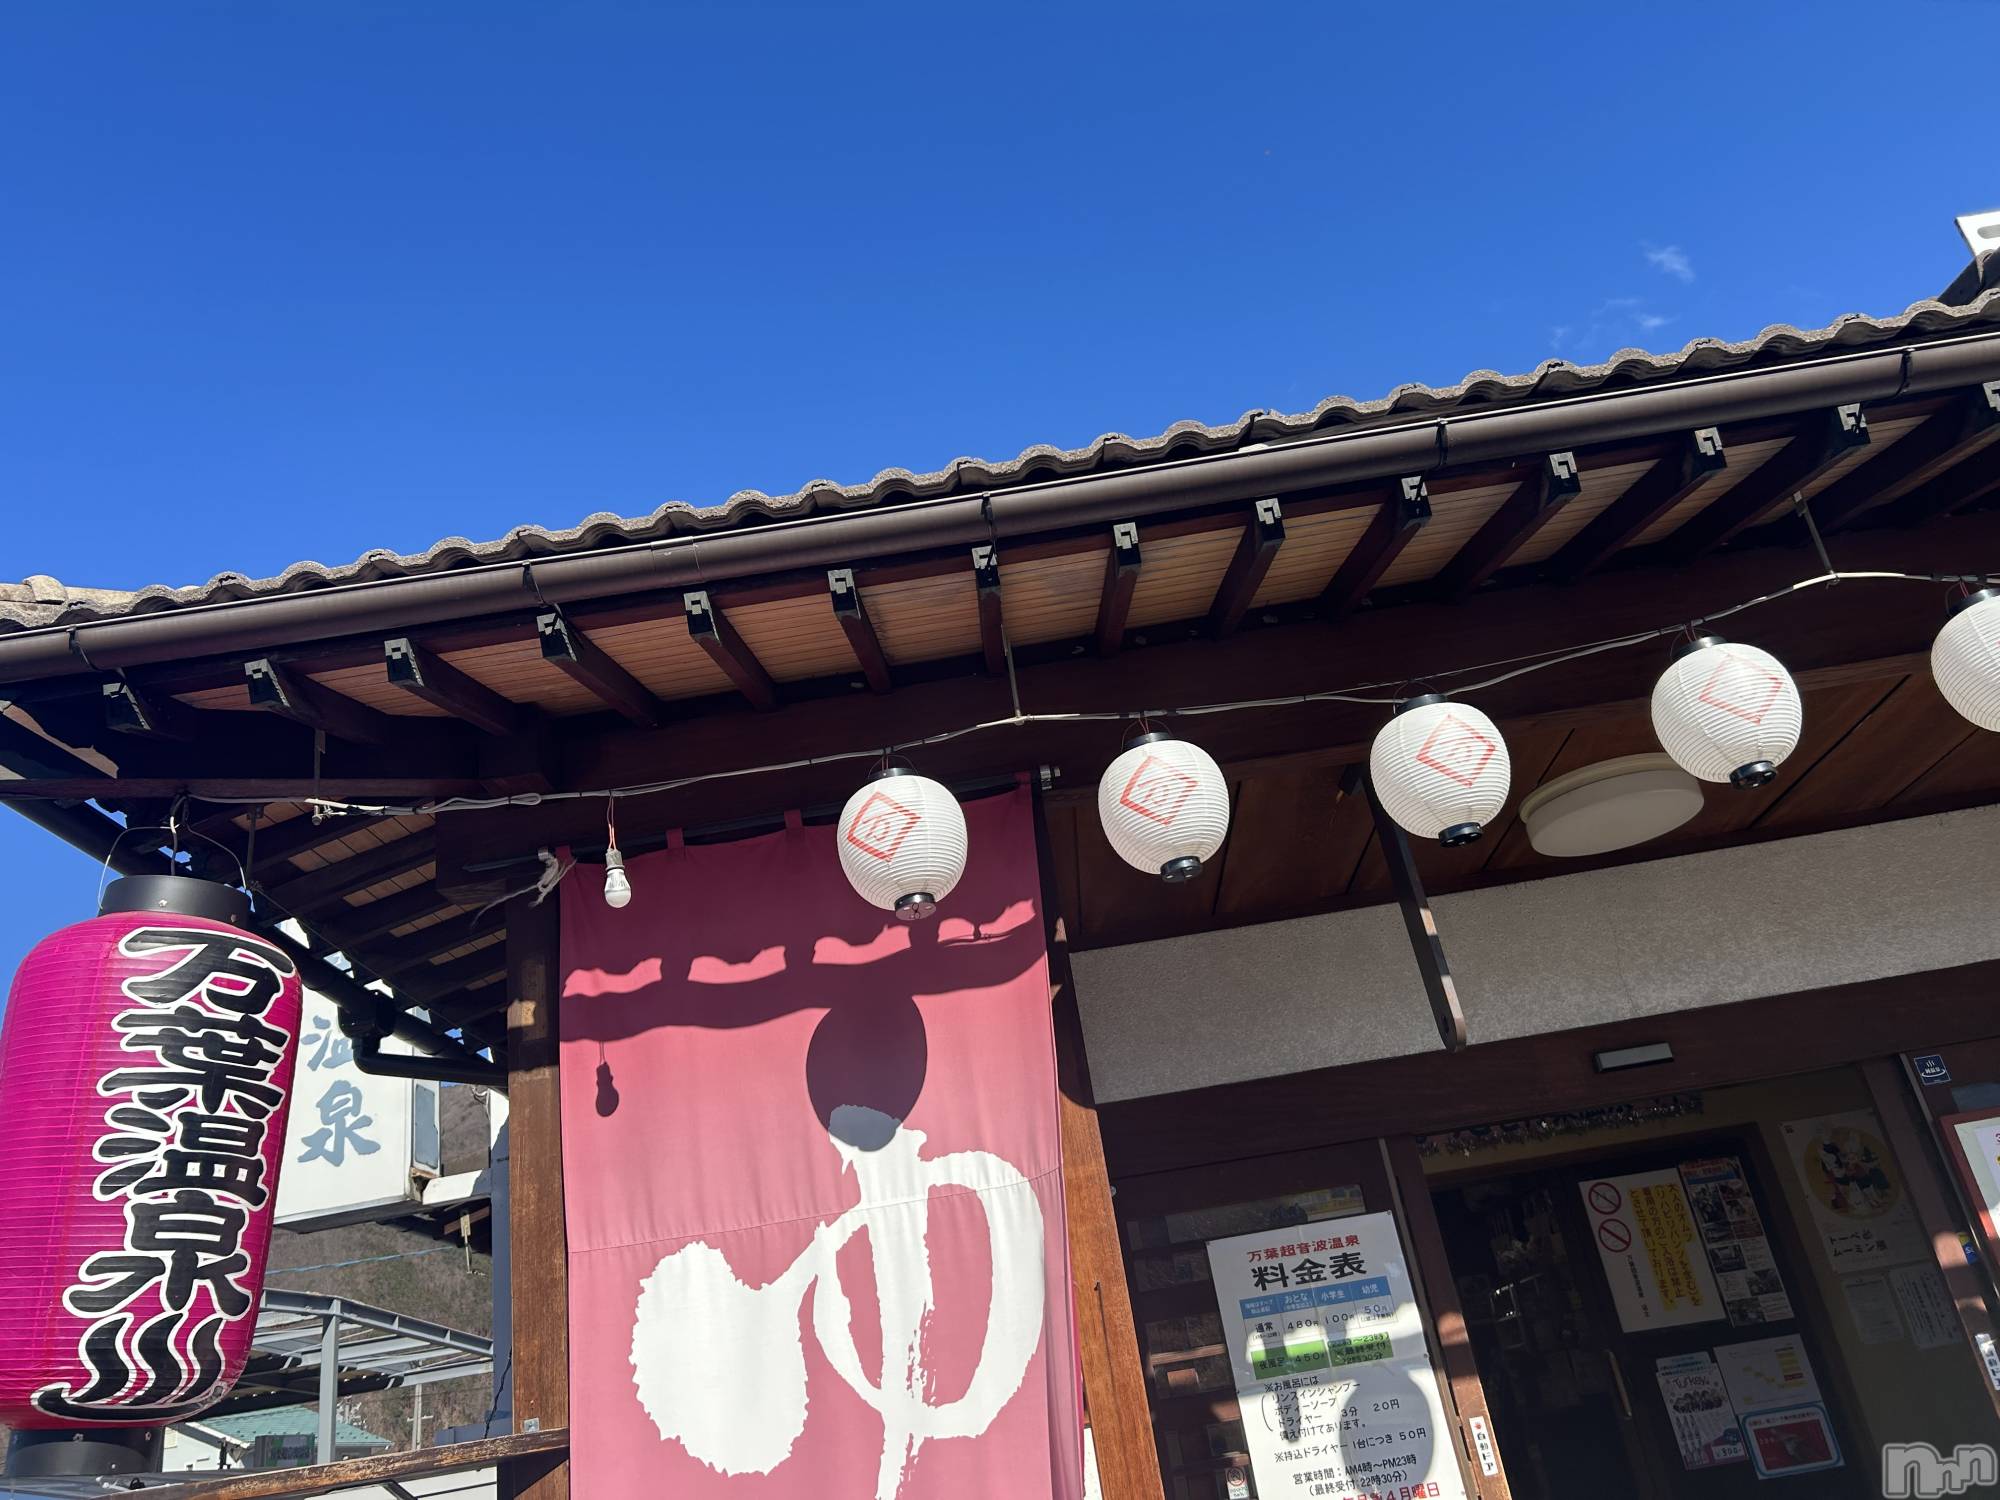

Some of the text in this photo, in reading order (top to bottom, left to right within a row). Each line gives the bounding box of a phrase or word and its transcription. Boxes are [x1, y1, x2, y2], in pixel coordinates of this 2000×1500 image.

[63, 926, 297, 1318] 万葉温泉
[1247, 1234, 1361, 1263] 万葉超音波温泉
[1251, 1252, 1368, 1292] 料金表
[1285, 1293, 1308, 1304] おとな
[1321, 1290, 1346, 1301] 小学生
[1361, 1283, 1380, 1295] 幼児
[629, 1104, 1046, 1500] ゆ
[1255, 1322, 1274, 1333] 通常
[1287, 1319, 1320, 1330] 480円
[1264, 1376, 1320, 1393] ※お風呂には
[1340, 1406, 1359, 1418] 3分
[1373, 1398, 1400, 1413] 20円
[1274, 1427, 1427, 1464] ※持込ドライヤー 1台につき 50円
[1477, 1432, 1494, 1471] 自動ドア
